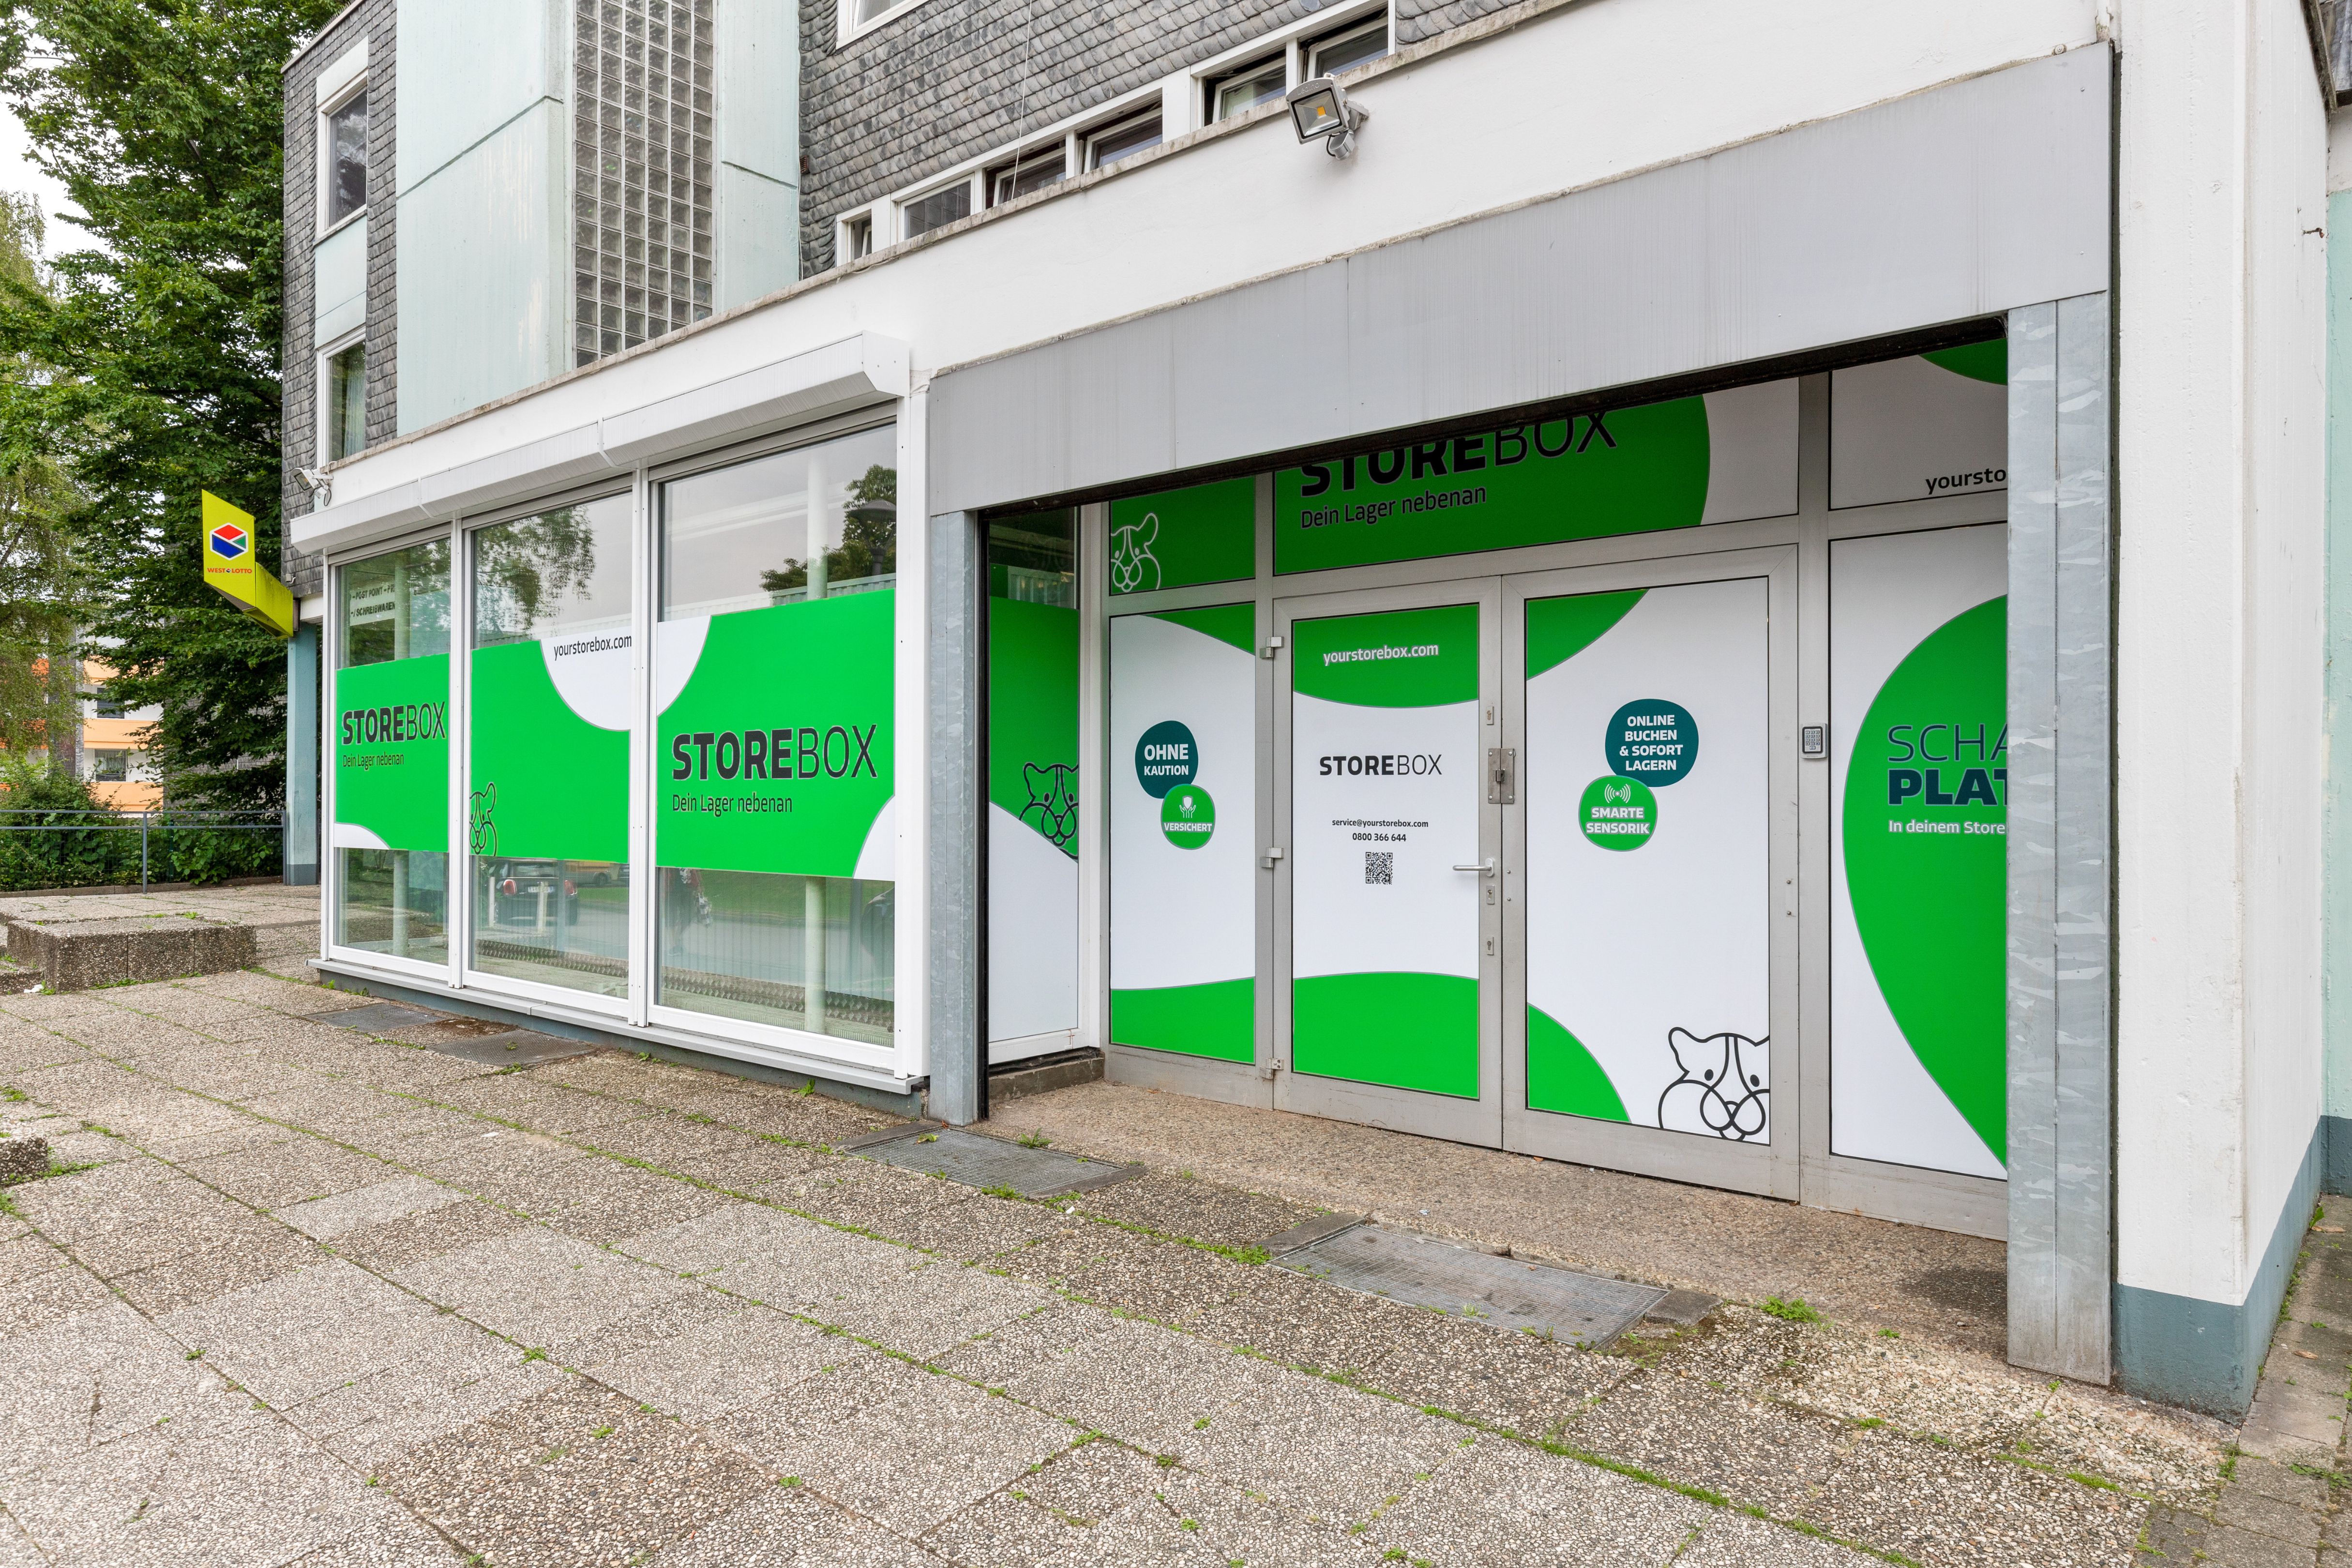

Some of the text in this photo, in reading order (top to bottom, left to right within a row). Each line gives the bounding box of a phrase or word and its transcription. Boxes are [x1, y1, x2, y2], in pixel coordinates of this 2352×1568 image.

[1301, 486, 1486, 528] Dein Lager nebenan
[554, 631, 632, 661] yourstorebox.com
[1323, 645, 1439, 666] yourstorebox.com
[343, 702, 445, 744] STOREBOX
[1627, 715, 1675, 726] ONLINE
[1625, 729, 1677, 741] BUCHEN
[673, 724, 877, 780] STOREBOX
[1145, 744, 1189, 761] OHNE
[1619, 744, 1683, 756] & SOFORT
[343, 752, 404, 770] Dein Lager nebenan
[1320, 754, 1442, 776] STOREBOX
[1626, 760, 1676, 771] LAGERN
[1144, 765, 1189, 776] KAUTION
[673, 791, 793, 817] Dein Lager nebenan
[1592, 808, 1644, 818] SMARTE
[1164, 823, 1212, 831] VERSICHERT
[1332, 818, 1429, 829] service@yourstorebox.com
[1586, 823, 1650, 833] SENSORIK
[1889, 821, 1902, 832] In
[1906, 820, 1960, 833] deinem
[1352, 832, 1406, 842] 0800 366 644
